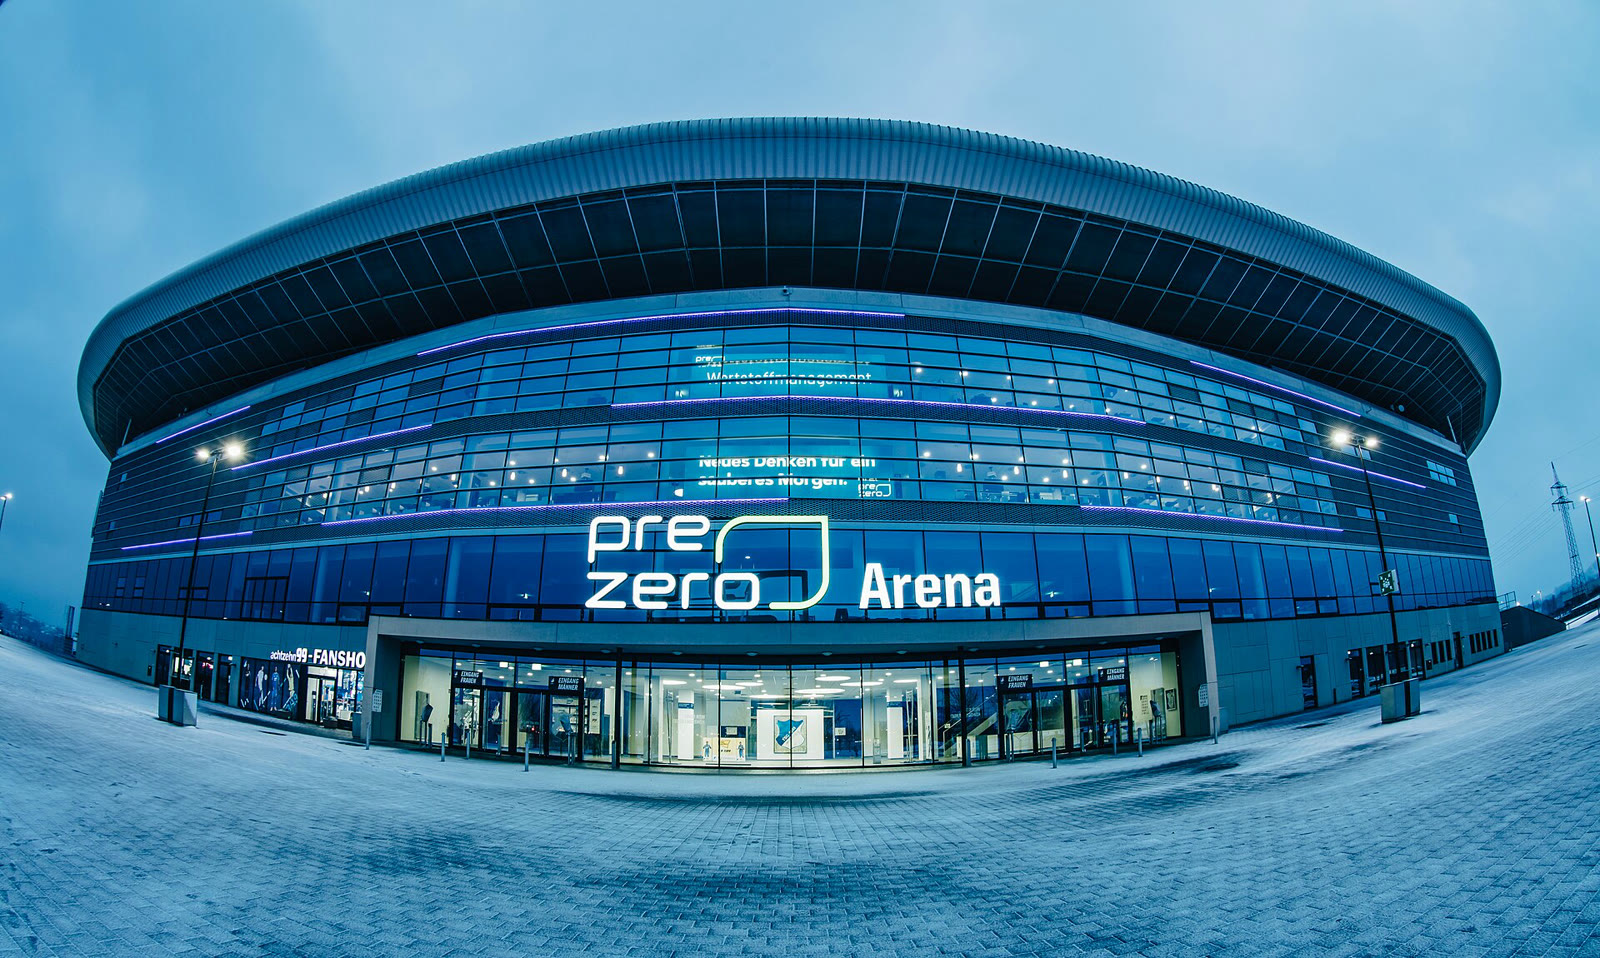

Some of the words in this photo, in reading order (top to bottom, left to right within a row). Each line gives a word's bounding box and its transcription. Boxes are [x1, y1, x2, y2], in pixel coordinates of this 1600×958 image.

[699, 455, 750, 467] Neues
[754, 456, 817, 467] Denken
[587, 515, 711, 564] pre
[585, 571, 760, 610] zero
[859, 562, 1002, 610] Arena
